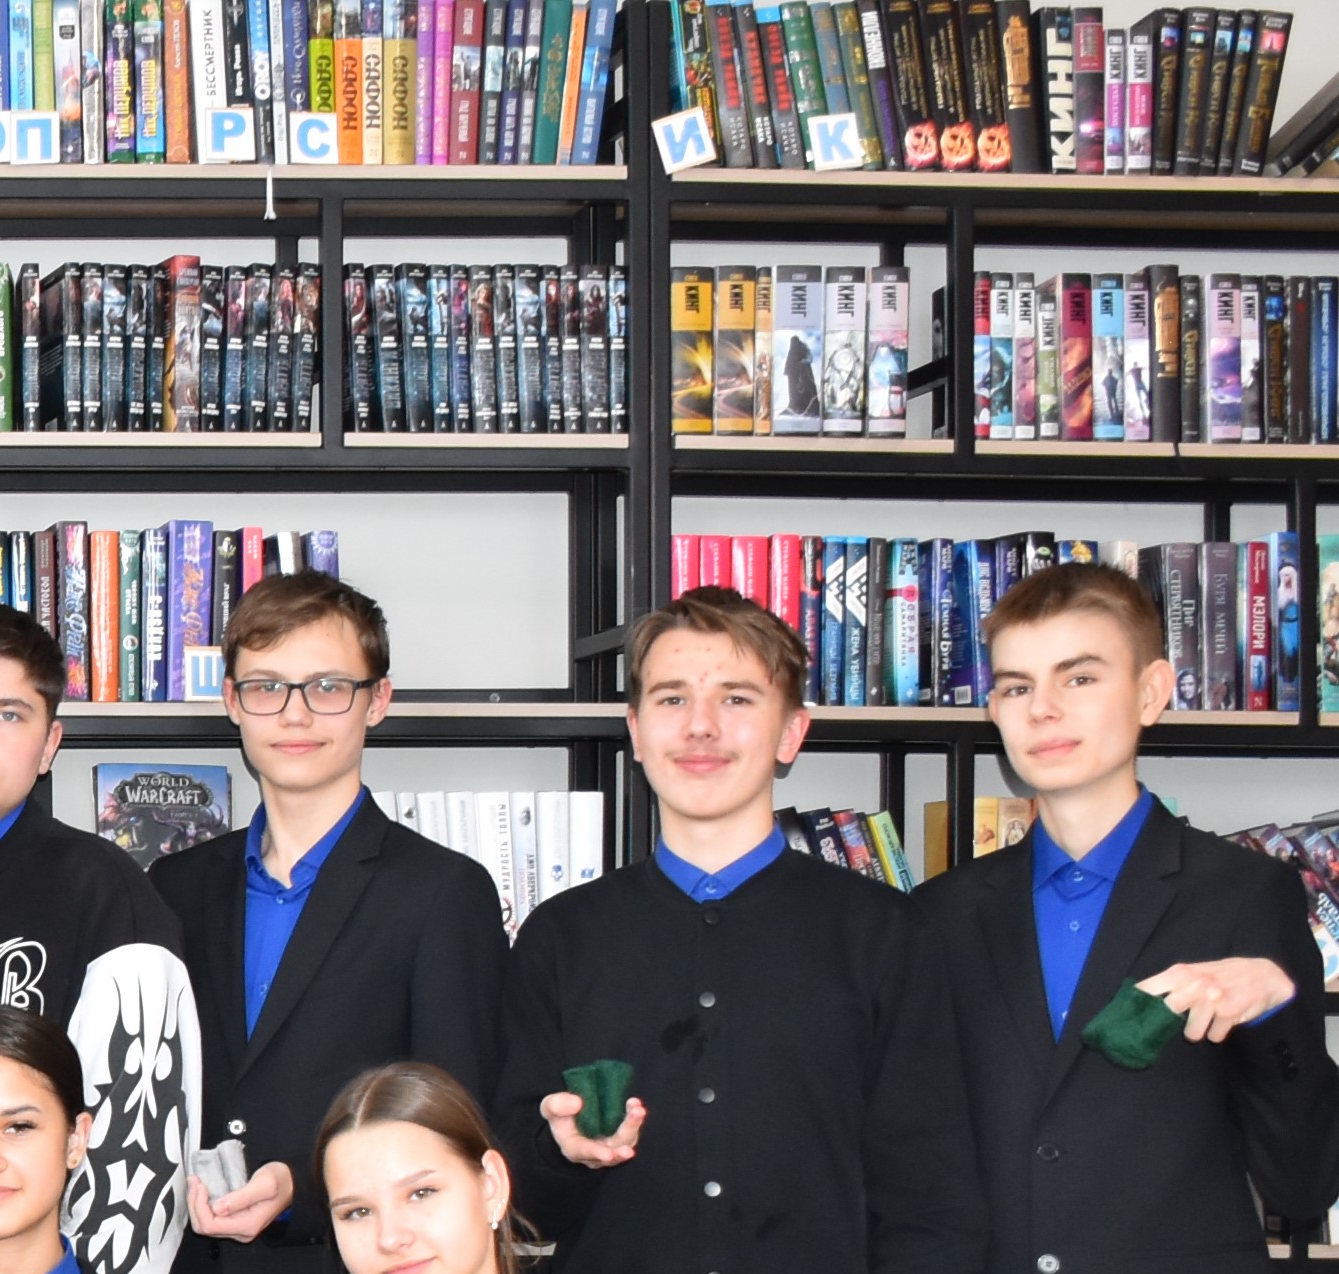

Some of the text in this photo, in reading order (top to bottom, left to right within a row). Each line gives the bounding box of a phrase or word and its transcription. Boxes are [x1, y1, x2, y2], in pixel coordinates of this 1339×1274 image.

[203, 10, 216, 97] БЕССМЕРТНИК
[1110, 47, 1121, 80] КИНГ
[1135, 48, 1147, 80] КИНГ
[343, 55, 358, 131] САФОН
[366, 53, 382, 129] САФОН
[393, 55, 409, 131] САФОН
[1046, 28, 1077, 171] КИНГ
[16, 119, 52, 161] П
[211, 112, 246, 153] Р
[297, 119, 331, 158] С
[661, 116, 707, 164] И
[815, 119, 854, 162] К
[686, 286, 699, 311] КИНГ
[730, 283, 743, 311] КИНГ
[758, 284, 771, 313] КИНГ
[791, 285, 806, 317] КИНГ
[838, 285, 854, 317] КИНГ
[882, 285, 897, 312] КИНГ
[975, 289, 989, 319] КИНГ
[996, 291, 1008, 317] КИНГ
[1019, 292, 1032, 324] КИНГ
[1070, 292, 1086, 324] КИНГ
[1101, 292, 1113, 317] КИНГ
[1130, 294, 1145, 326] КИНГ
[1219, 292, 1233, 324] КИНГ
[1243, 295, 1255, 320] КИНГ
[1041, 315, 1055, 346] КИНГ
[1170, 568, 1183, 659] СТЕРВЯТНИКОВ
[1181, 598, 1196, 627] ПИР
[1252, 596, 1267, 649] МЭЛОРИ
[849, 626, 861, 701] ЖЕНА УБИЙЦЫ
[125, 784, 202, 806] WARCRAFT
[137, 776, 189, 788] WORLD
[500, 840, 511, 891] МУДРОСТЬ
